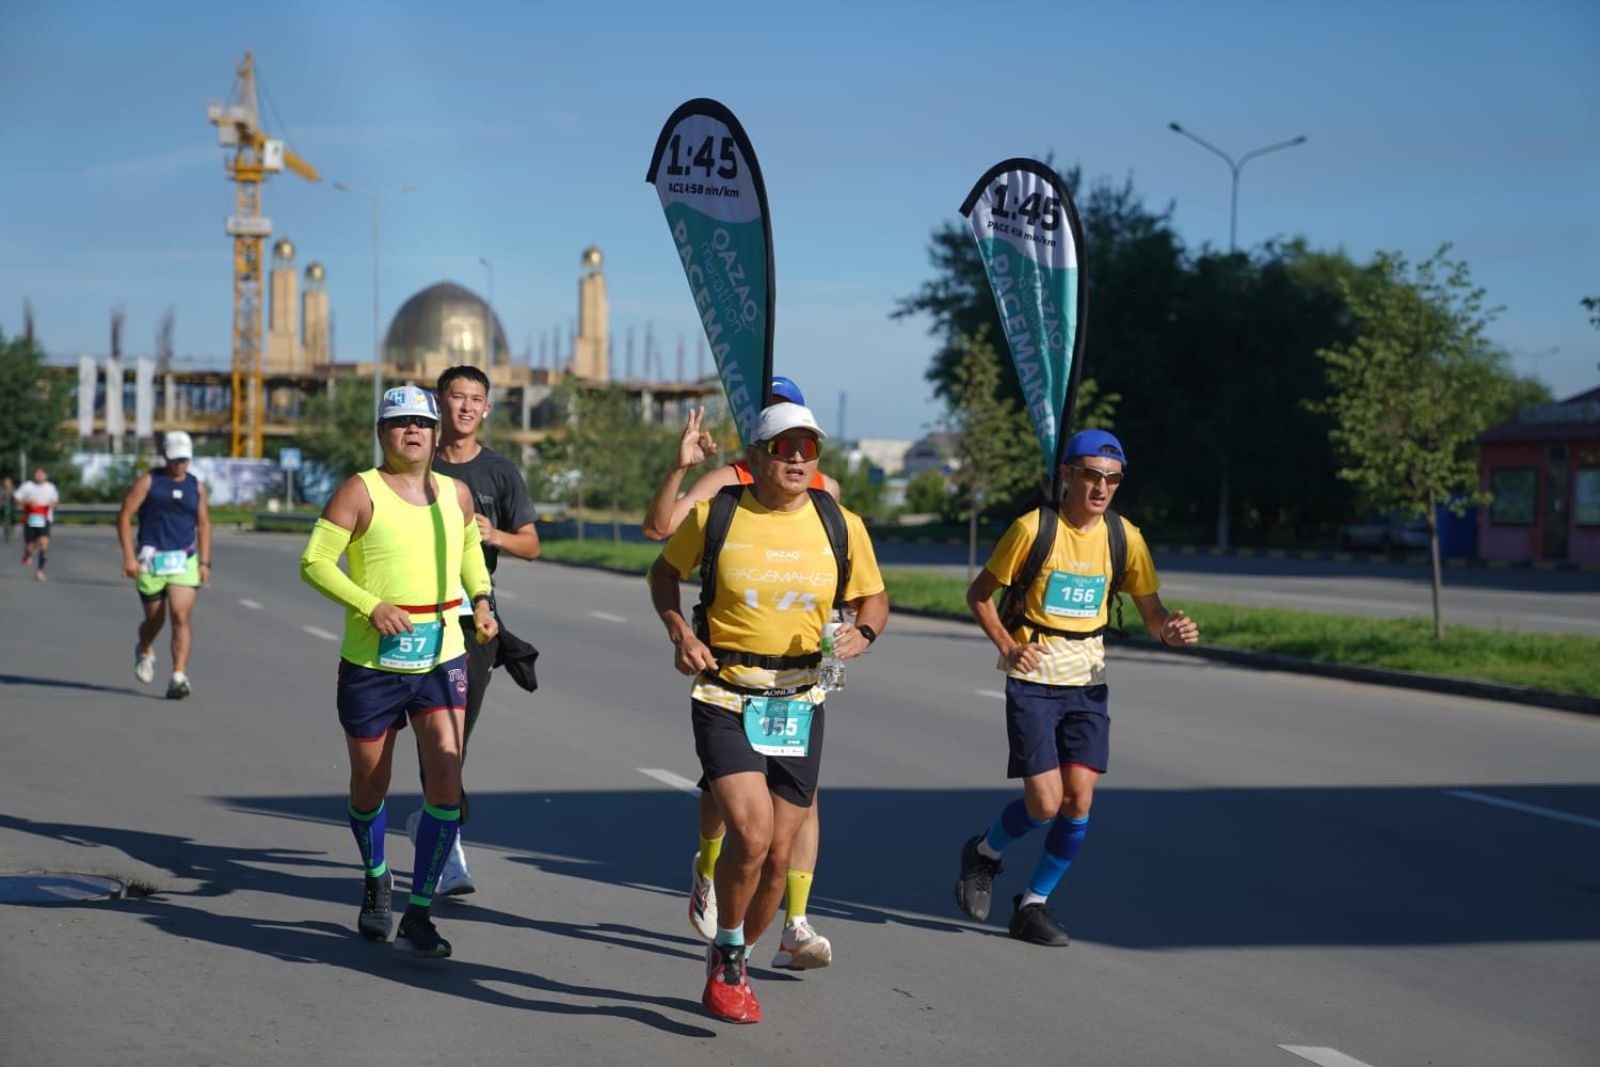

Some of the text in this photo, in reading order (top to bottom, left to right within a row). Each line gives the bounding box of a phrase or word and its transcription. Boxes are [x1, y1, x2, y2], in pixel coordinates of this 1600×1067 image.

[667, 134, 738, 180] 1:45
[991, 184, 1061, 231] 1:45
[700, 241, 742, 335] marathon
[711, 228, 758, 327] QAZAQ
[673, 218, 758, 431] PACEMAKER
[991, 253, 1055, 438] PACEMAKER
[1061, 586, 1096, 603] 156
[399, 636, 427, 653] 57
[758, 716, 799, 736] 155
